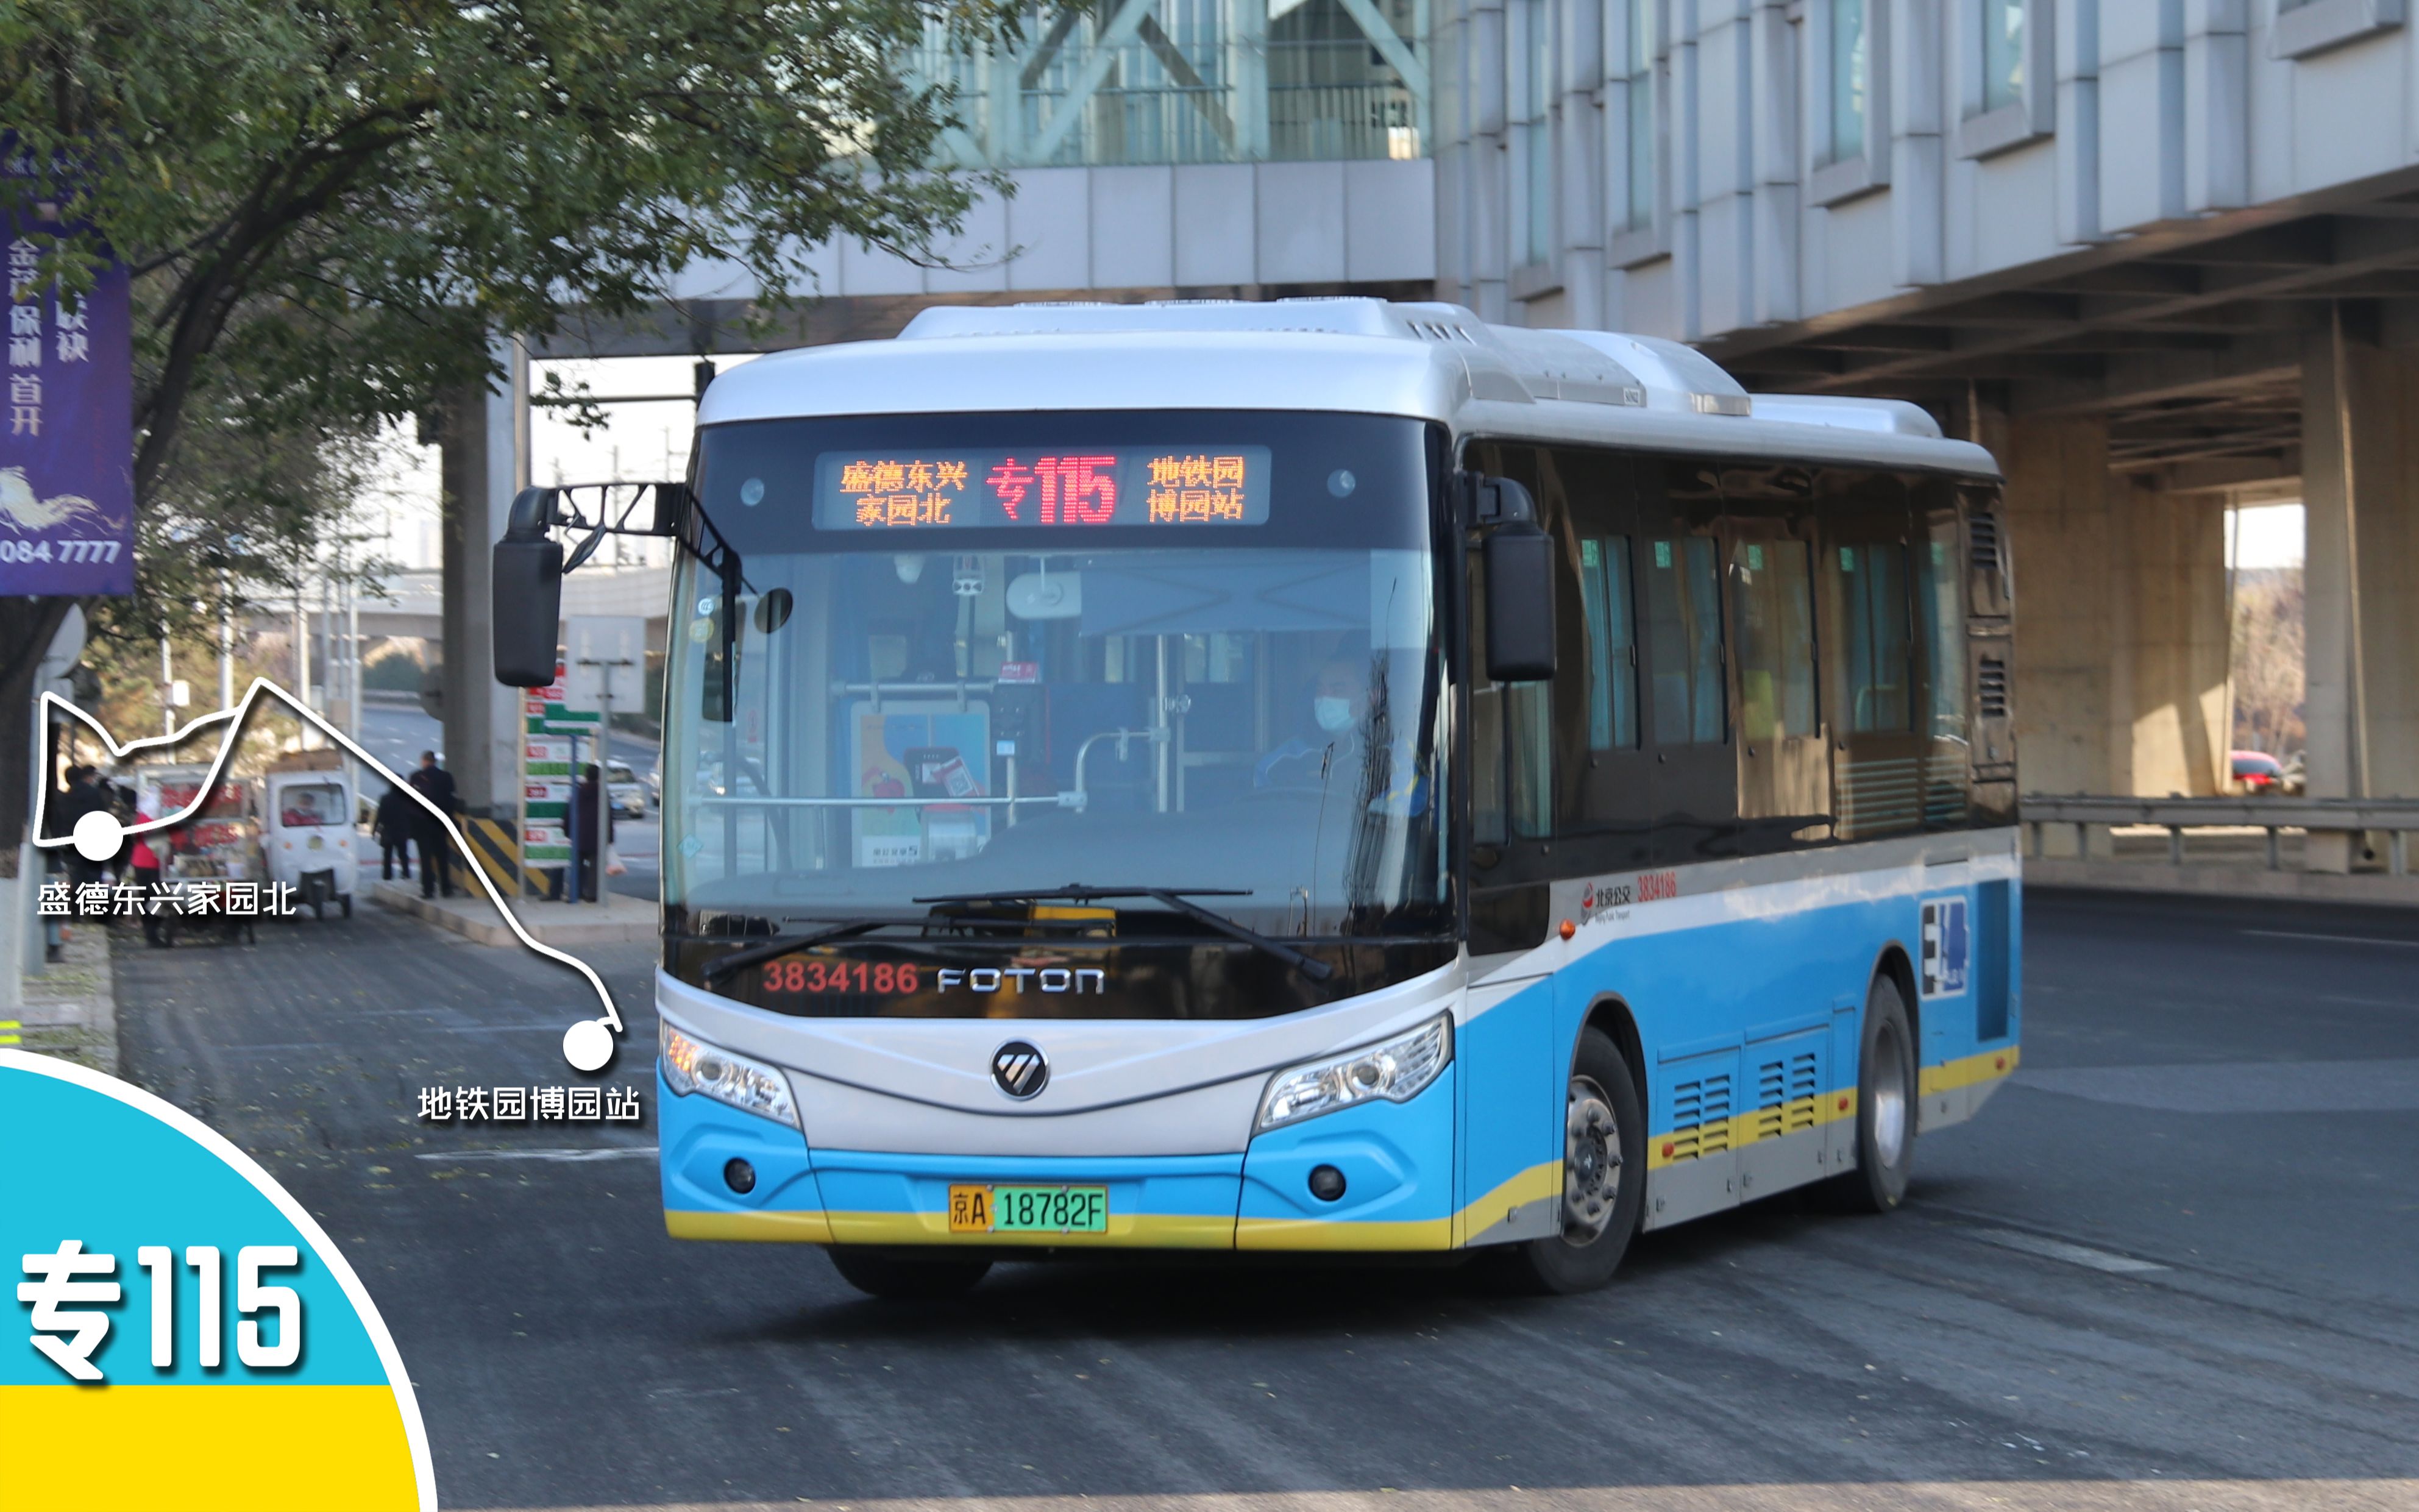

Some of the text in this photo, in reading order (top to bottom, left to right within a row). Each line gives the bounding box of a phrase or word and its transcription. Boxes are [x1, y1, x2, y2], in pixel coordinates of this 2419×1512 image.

[840, 460, 968, 494] 盛德东兴
[1146, 455, 1244, 489] 地铁园
[855, 492, 952, 527] 家园北
[1146, 488, 1245, 523] 博园站
[57, 540, 122, 564] 7777
[1596, 871, 1677, 907] 北京公交 3834186
[763, 962, 1105, 995] 3834186 FOTON
[953, 1192, 1104, 1227] 京A 18782F
